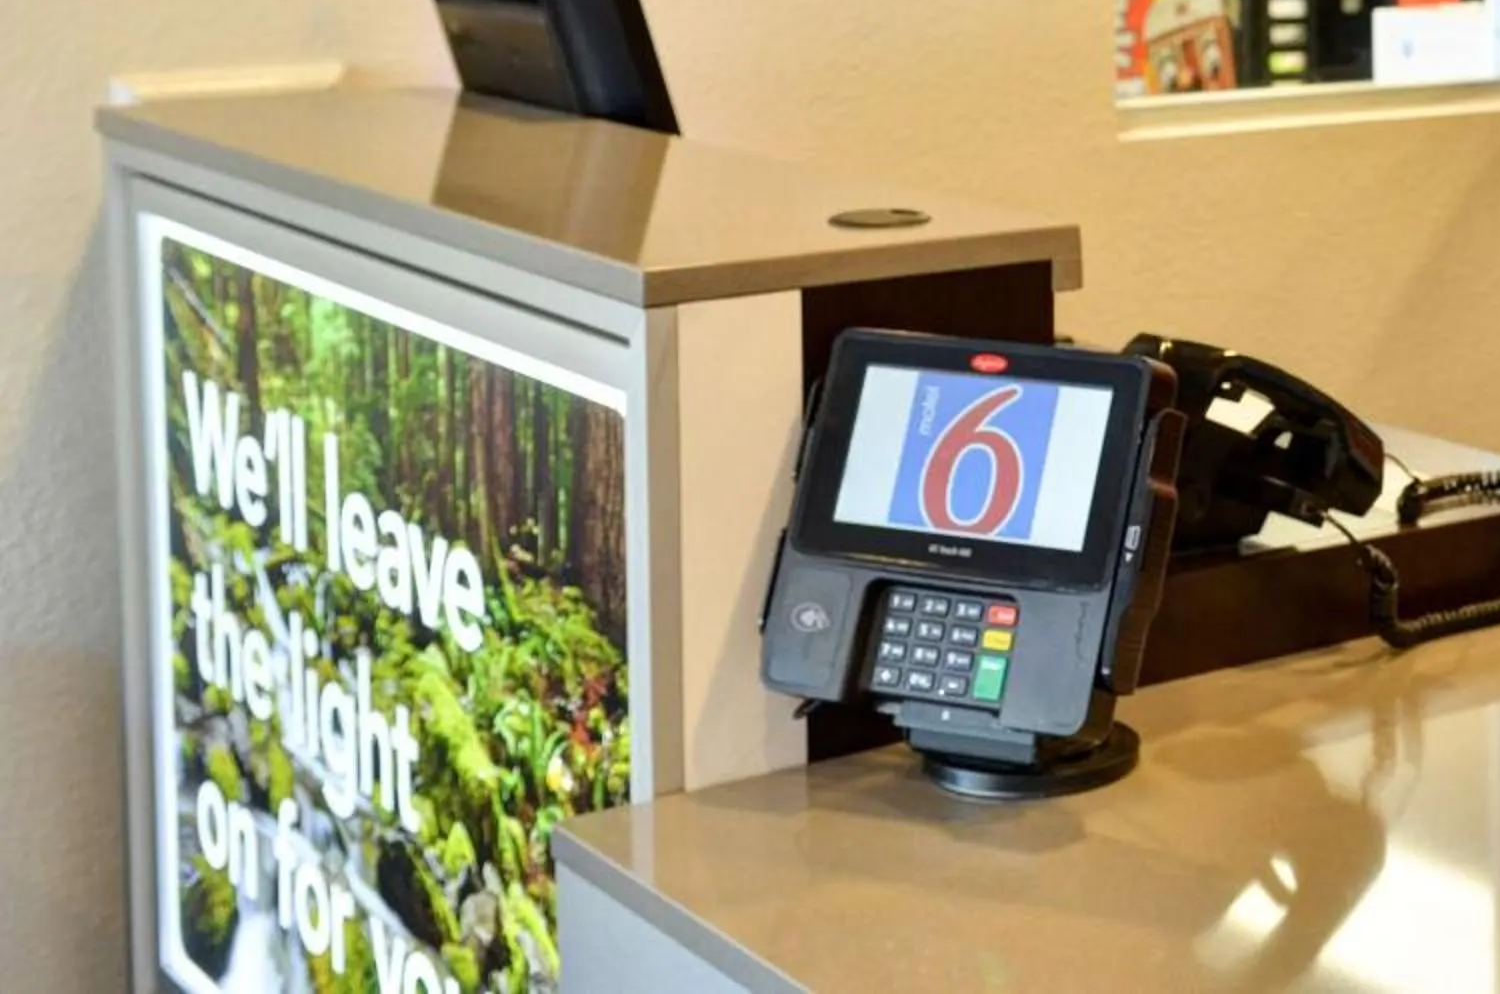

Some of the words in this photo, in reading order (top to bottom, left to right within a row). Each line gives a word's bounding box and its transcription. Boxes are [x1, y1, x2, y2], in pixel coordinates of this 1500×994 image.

[182, 370, 307, 552] We'll
[323, 432, 484, 651] leave
[918, 384, 1024, 536] 6
[191, 563, 272, 720] the
[289, 611, 420, 833] light
[197, 780, 257, 900] on
[273, 797, 355, 975] for
